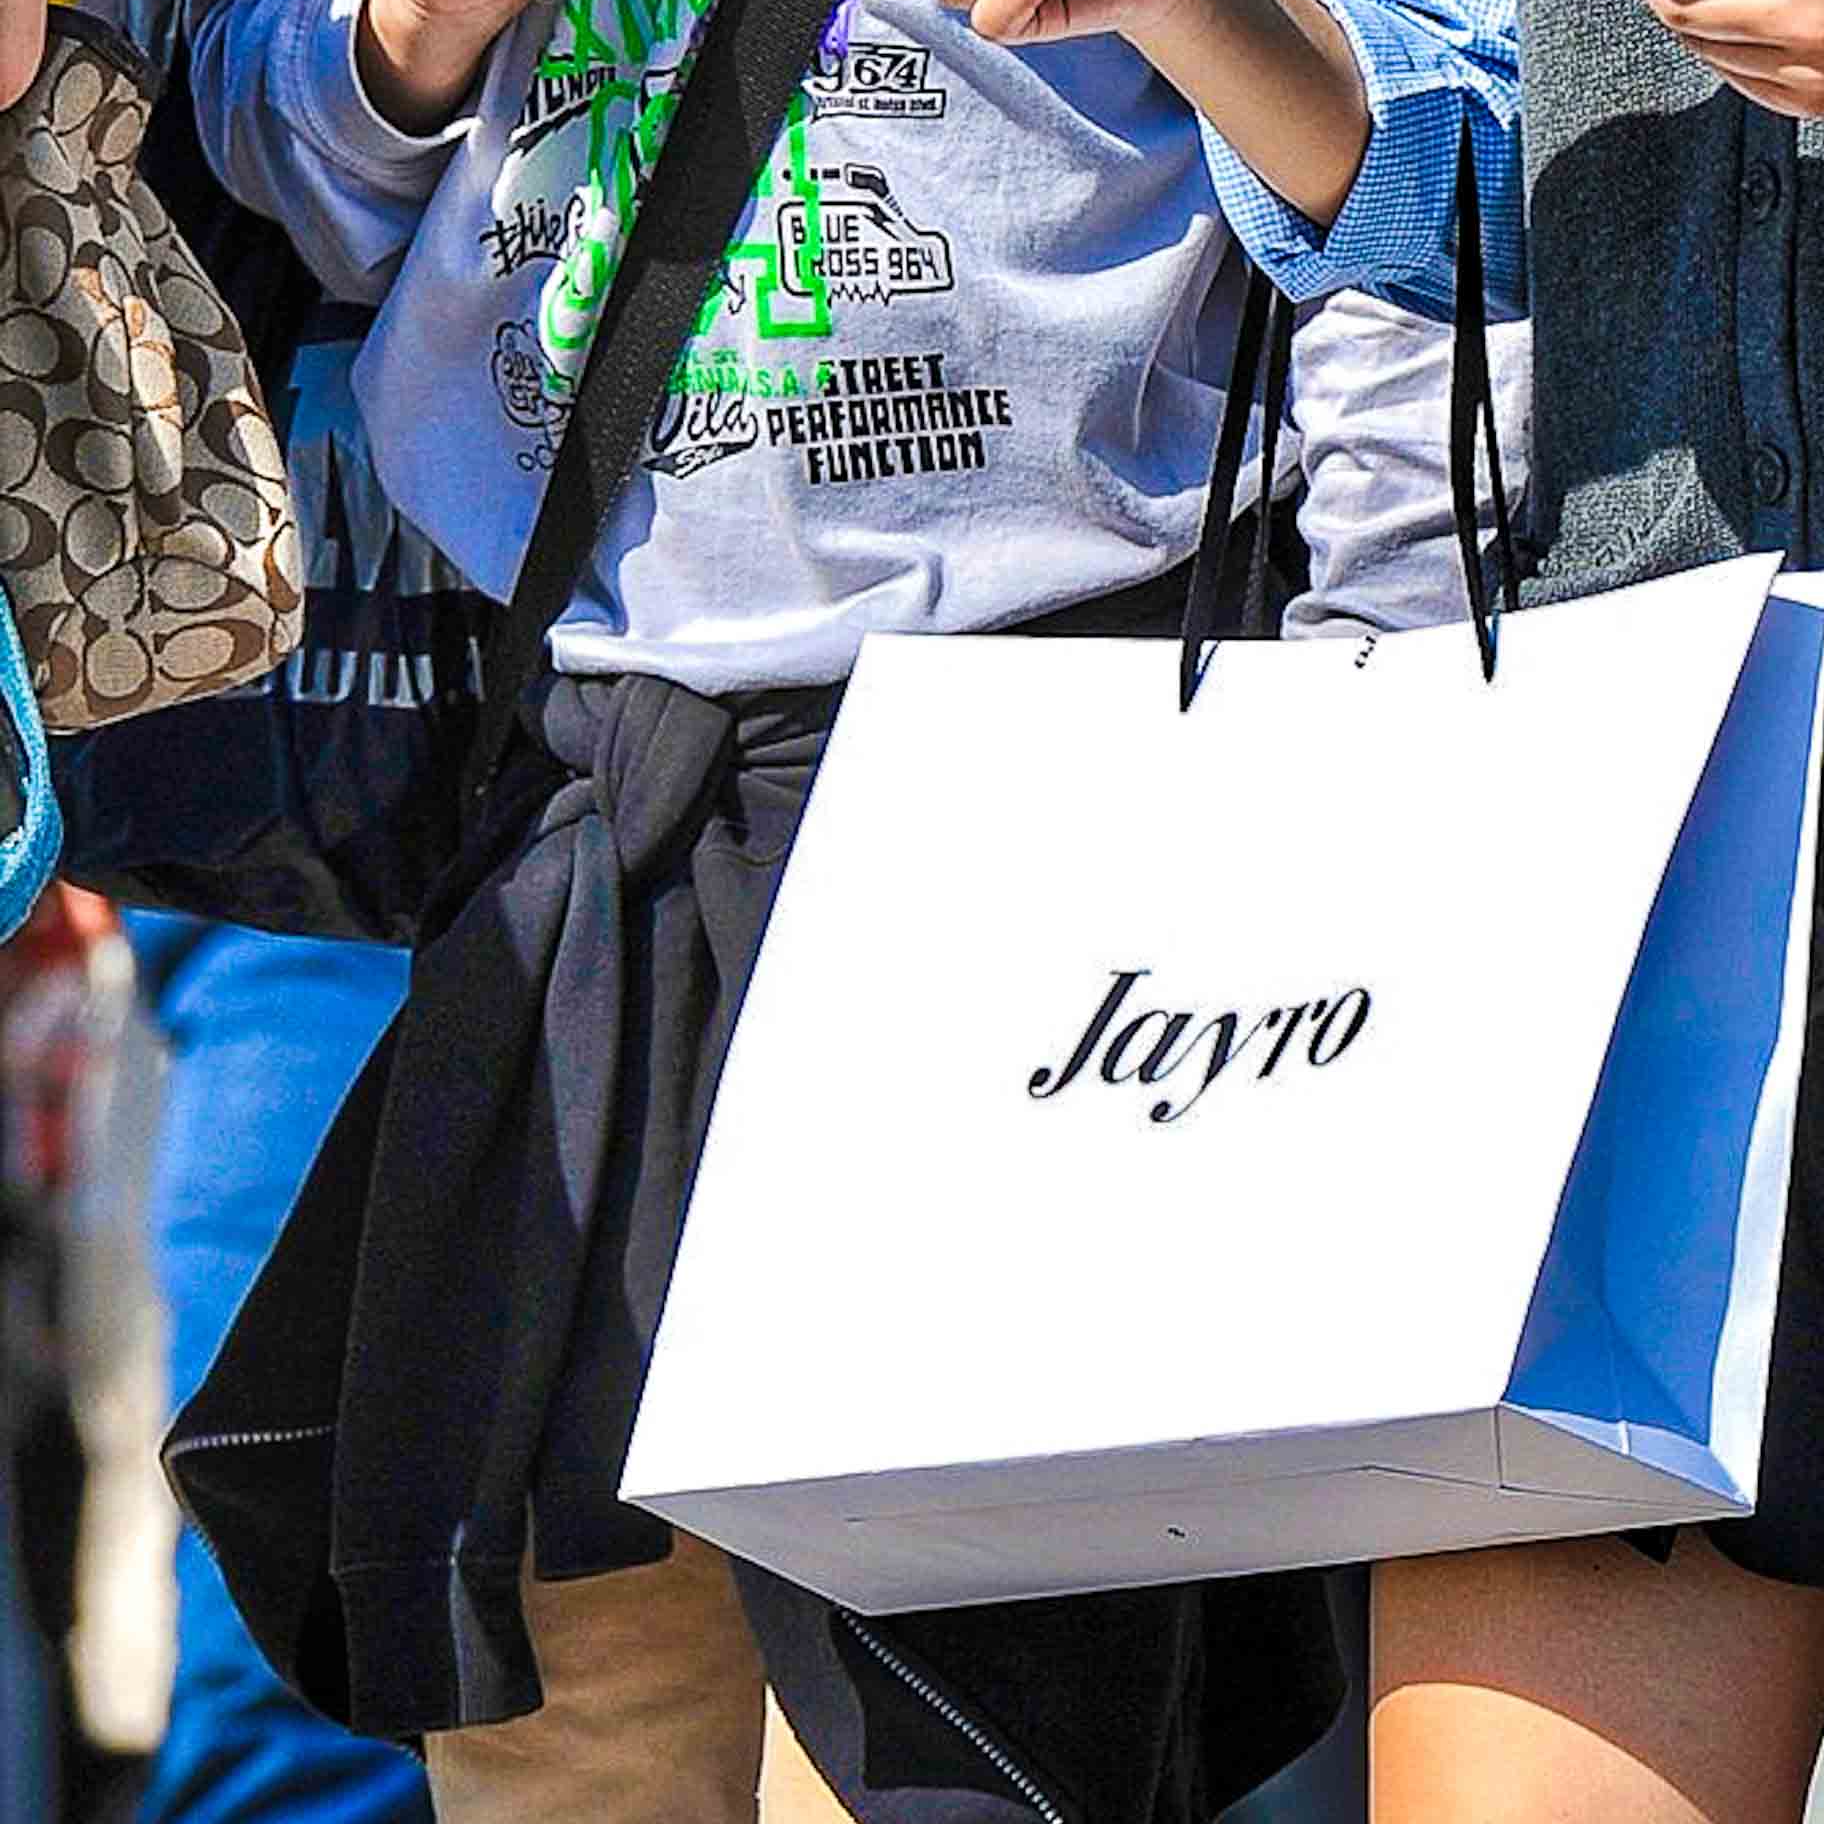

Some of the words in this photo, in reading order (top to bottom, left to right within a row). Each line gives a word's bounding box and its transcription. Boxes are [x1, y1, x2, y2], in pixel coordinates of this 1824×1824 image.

[853, 52, 918, 89] 674
[888, 246, 940, 281] 964
[817, 353, 945, 397] STREET
[766, 389, 1013, 446] PERFORMANCE
[807, 431, 987, 485] FUNCTION
[1028, 969, 1371, 1123] Jayro
